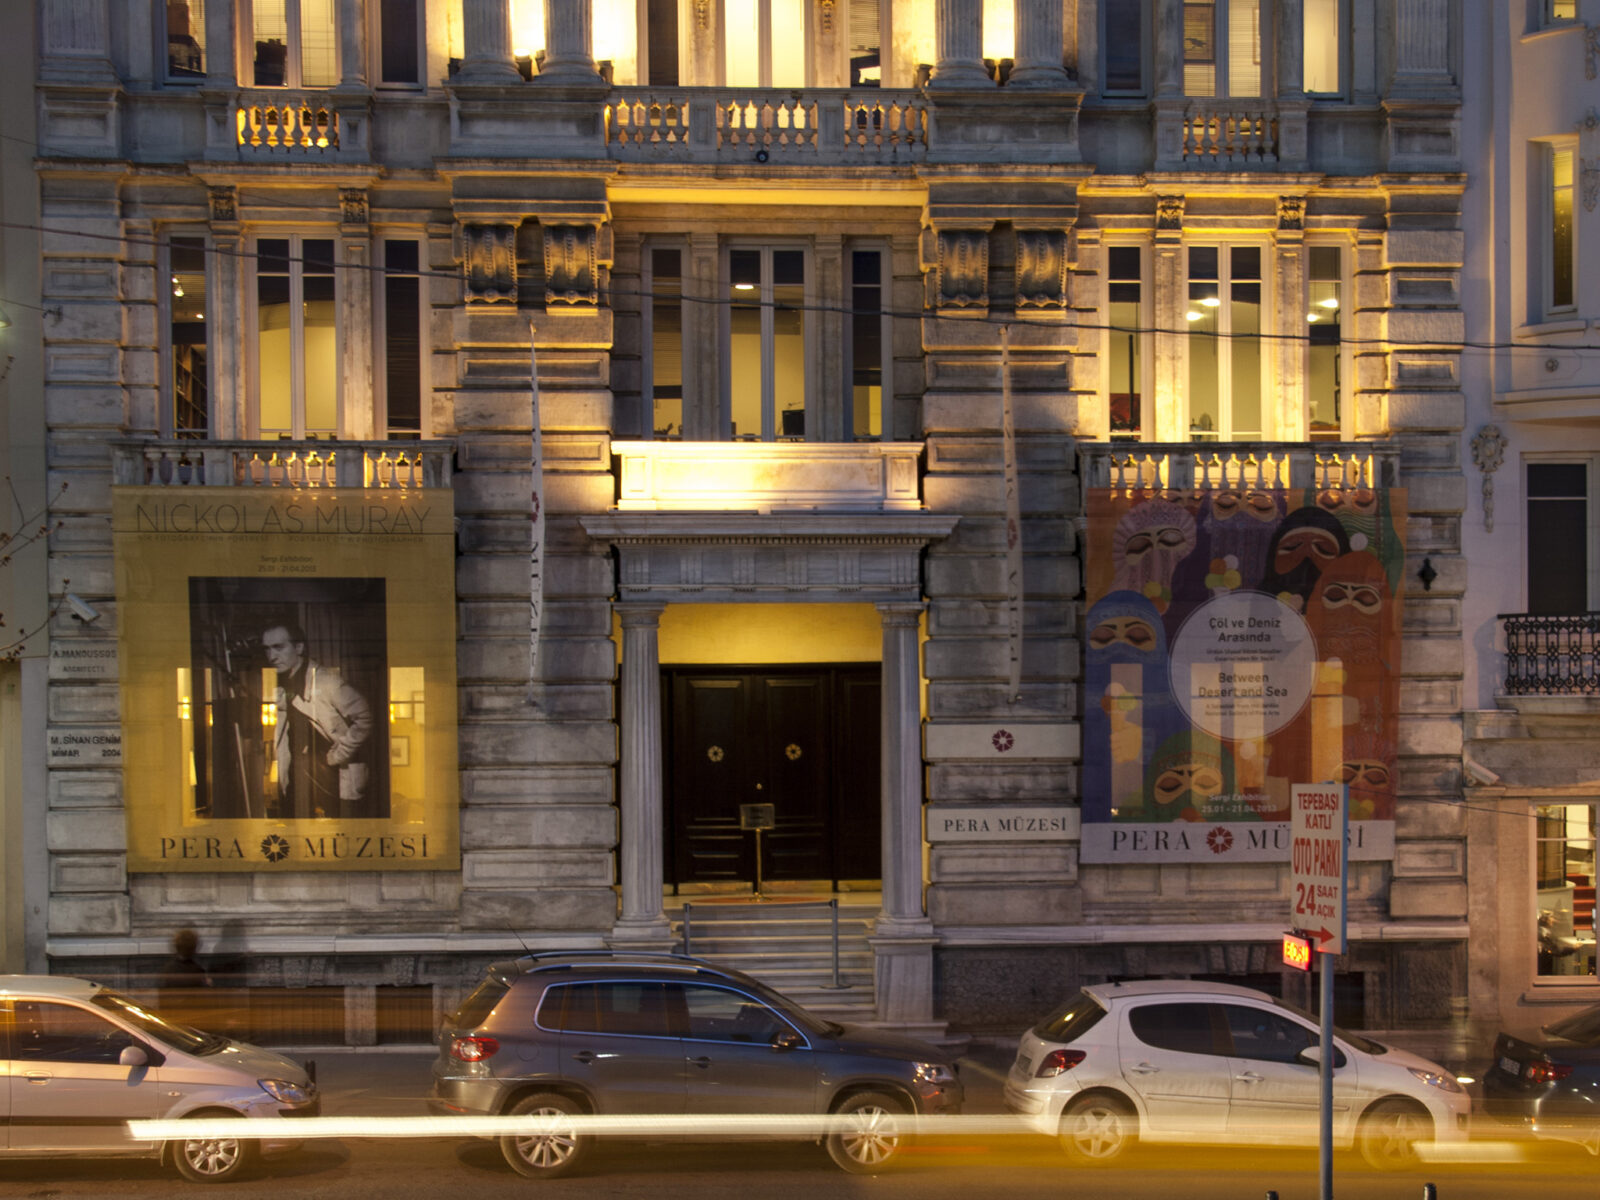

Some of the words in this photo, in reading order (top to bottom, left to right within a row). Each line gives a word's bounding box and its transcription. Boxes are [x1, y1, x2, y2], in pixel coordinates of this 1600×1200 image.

[137, 504, 304, 533] NICKOLAS
[316, 505, 432, 534] MURAY
[1209, 617, 1228, 630] Çöl
[1231, 619, 1245, 628] ve
[1248, 617, 1281, 628] Deniz
[1218, 632, 1271, 642] Arasında
[1218, 672, 1269, 683] Between
[1198, 687, 1237, 697] Desert
[1240, 687, 1263, 697] and
[1265, 687, 1288, 697] Sea
[1297, 793, 1339, 814] TEPEBAŞI
[944, 819, 990, 832] PERA
[998, 816, 1067, 832] MÜZESİ
[1305, 814, 1332, 830] KATLI
[160, 837, 245, 859] PERA
[304, 833, 430, 858] MÜZESİ
[1111, 829, 1191, 851] PERA
[1293, 837, 1312, 876] OTO
[1314, 839, 1341, 878] PARKI
[1295, 883, 1316, 916] 24
[1316, 885, 1338, 899] SAAT
[1316, 906, 1336, 921] AÇIK
